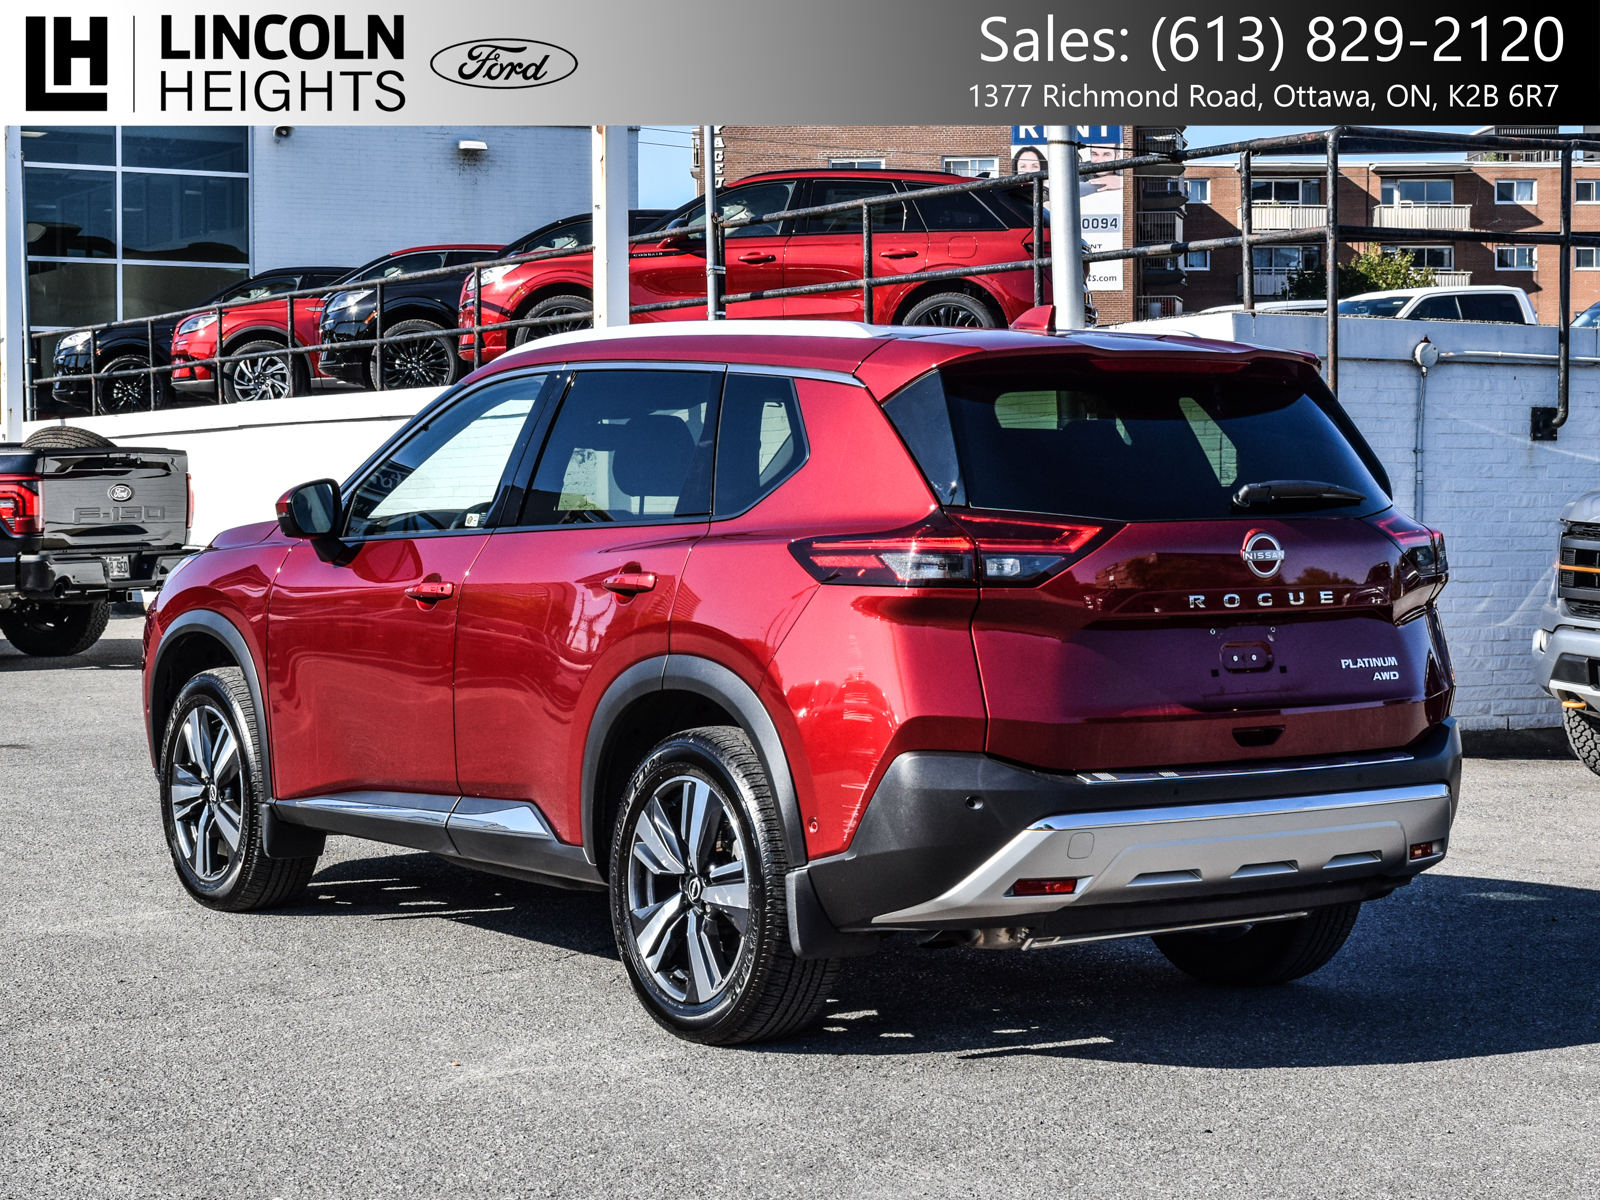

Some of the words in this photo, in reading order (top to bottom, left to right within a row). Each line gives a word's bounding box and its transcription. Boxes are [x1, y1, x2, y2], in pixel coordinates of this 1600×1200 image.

[113, 486, 131, 499] Ford
[73, 506, 165, 524] F-150
[1244, 550, 1284, 560] NISSAN
[1188, 590, 1334, 608] ROGUE
[1340, 656, 1398, 669] PLATINUM
[1373, 671, 1400, 681] AWD
